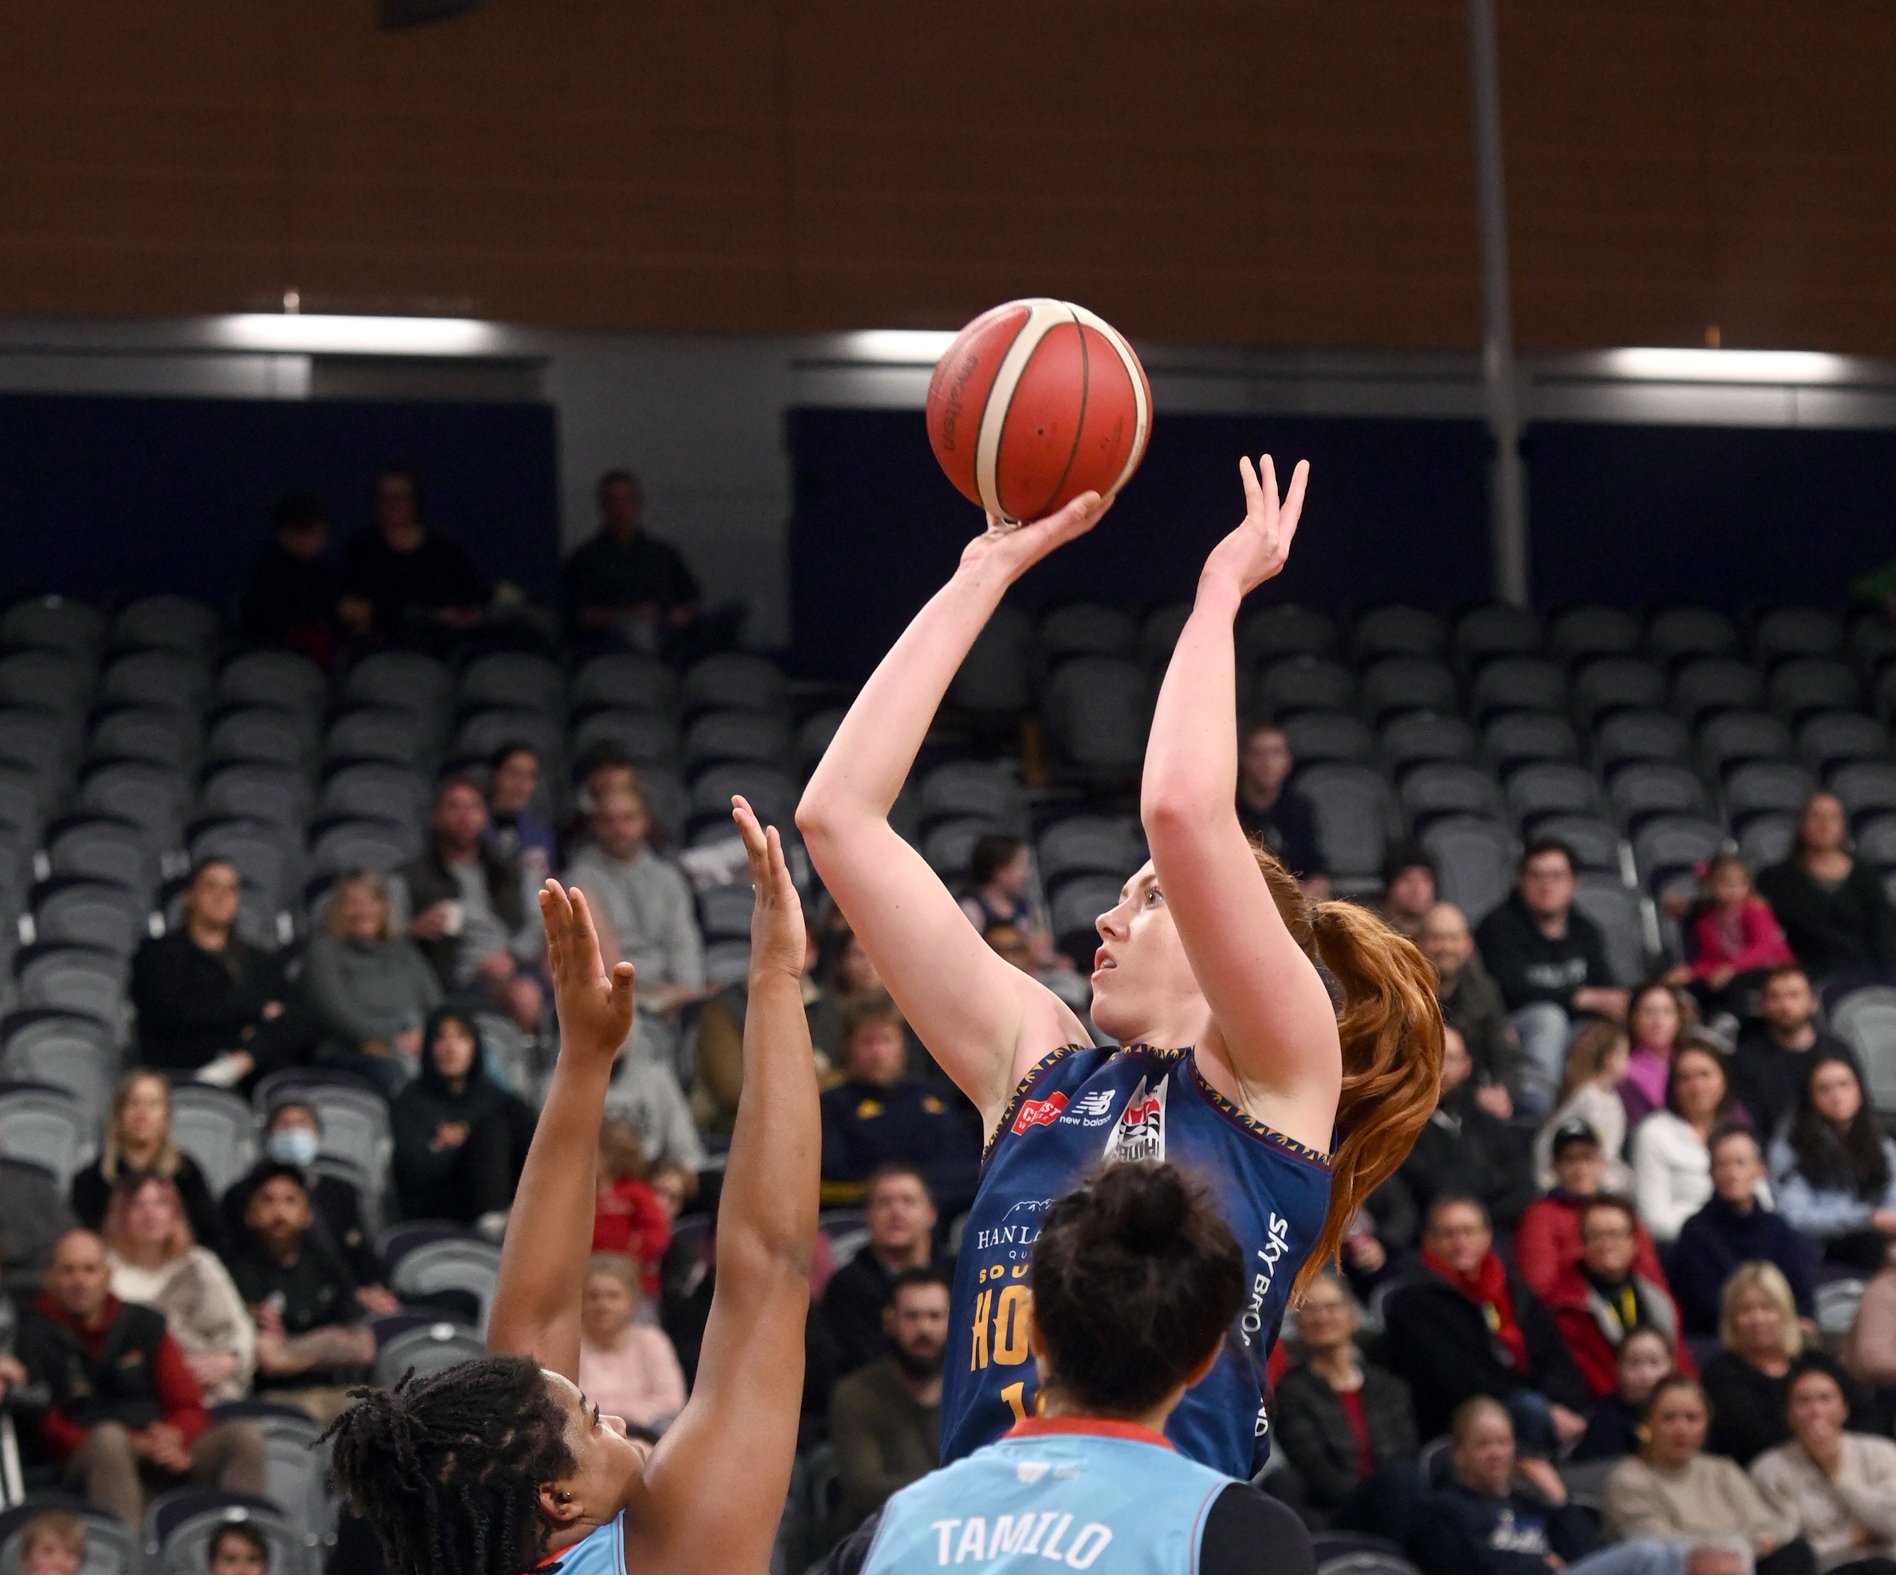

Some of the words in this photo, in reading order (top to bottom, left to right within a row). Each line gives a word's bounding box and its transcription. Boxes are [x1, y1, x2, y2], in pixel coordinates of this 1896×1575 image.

[1059, 1115, 1081, 1126] new
[1083, 1114, 1112, 1127] balance
[932, 1510, 1112, 1571] TAMILO
